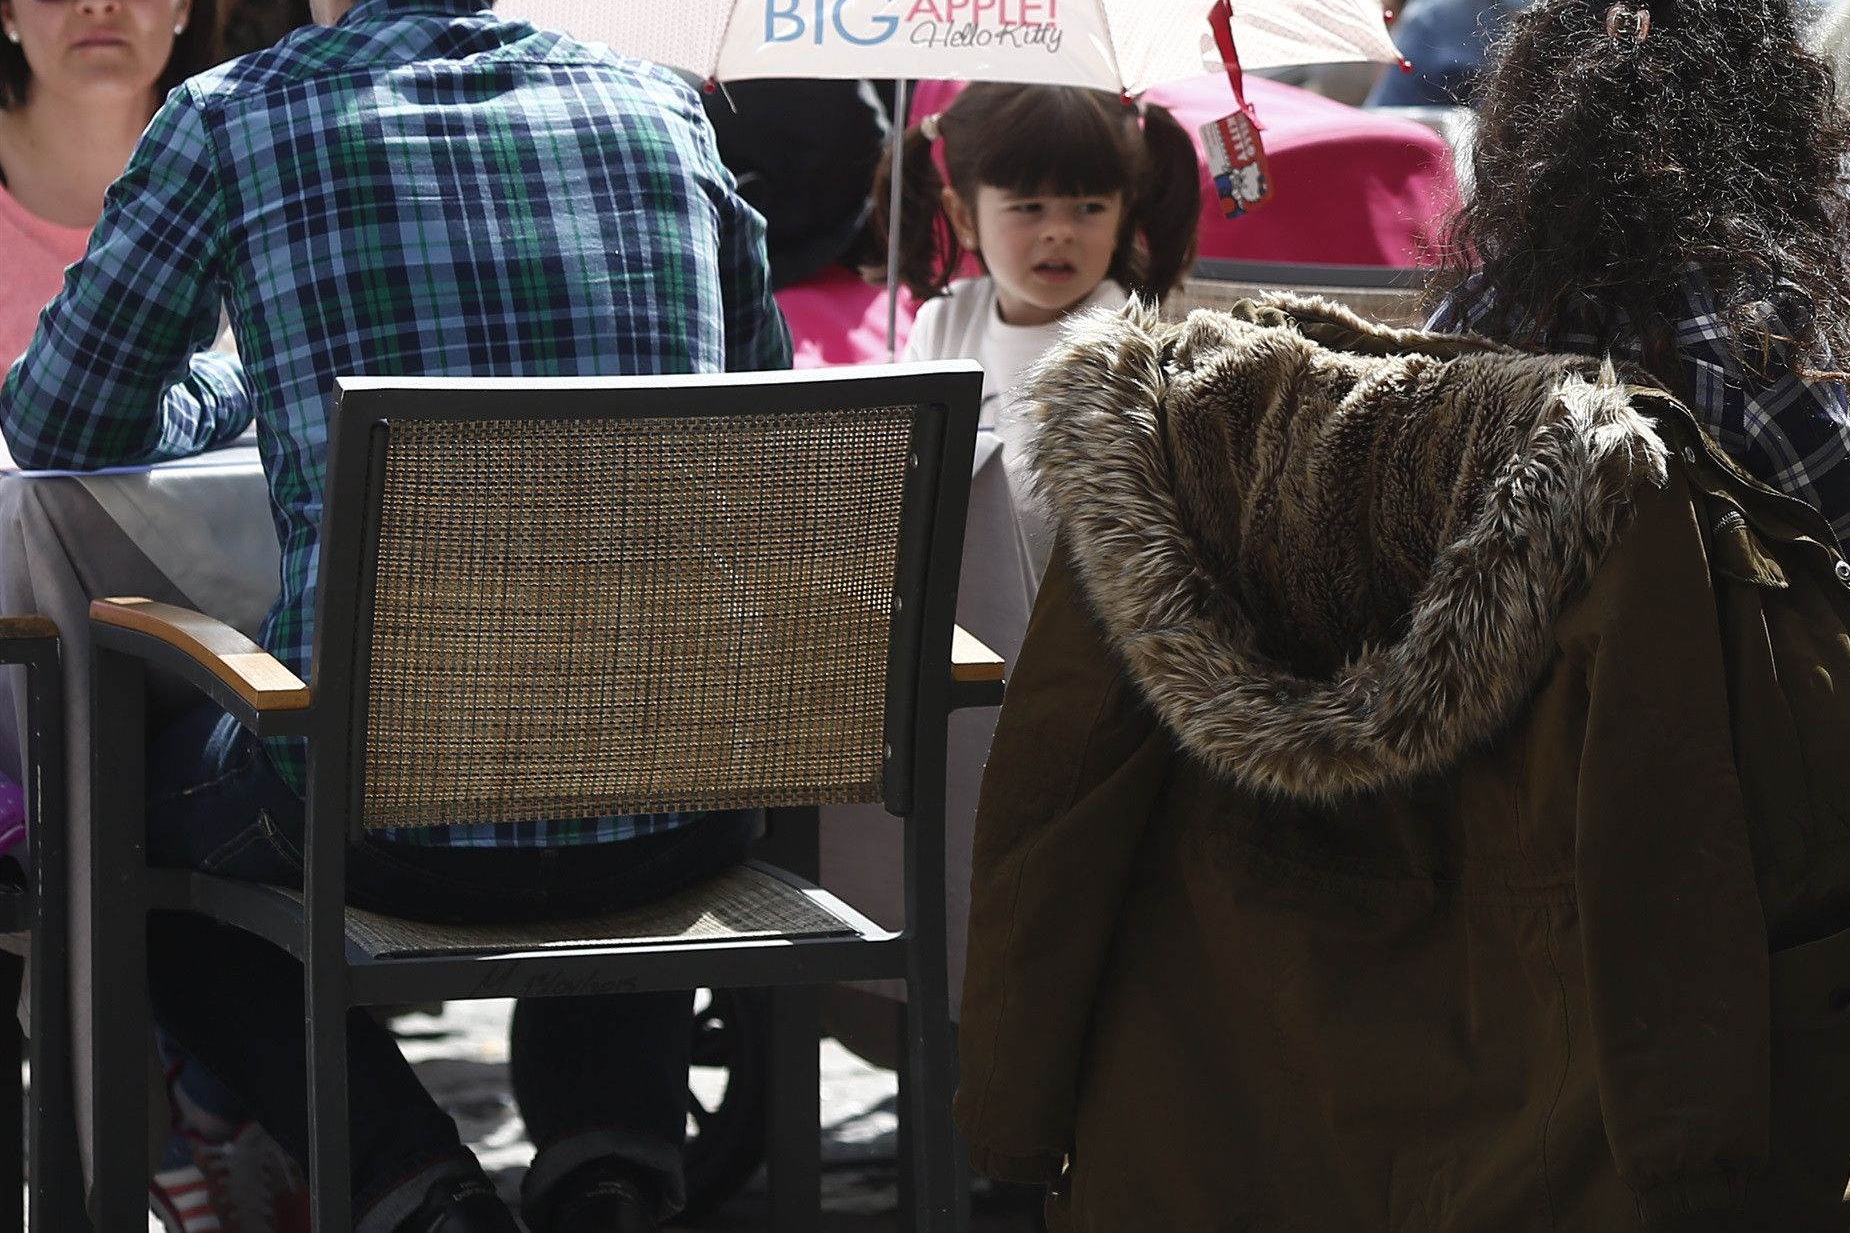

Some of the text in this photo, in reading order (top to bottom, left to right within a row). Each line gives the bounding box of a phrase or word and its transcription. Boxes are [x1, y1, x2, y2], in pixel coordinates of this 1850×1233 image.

[910, 20, 1064, 54] Hello Kitty
[1226, 117, 1249, 161] KITTY
